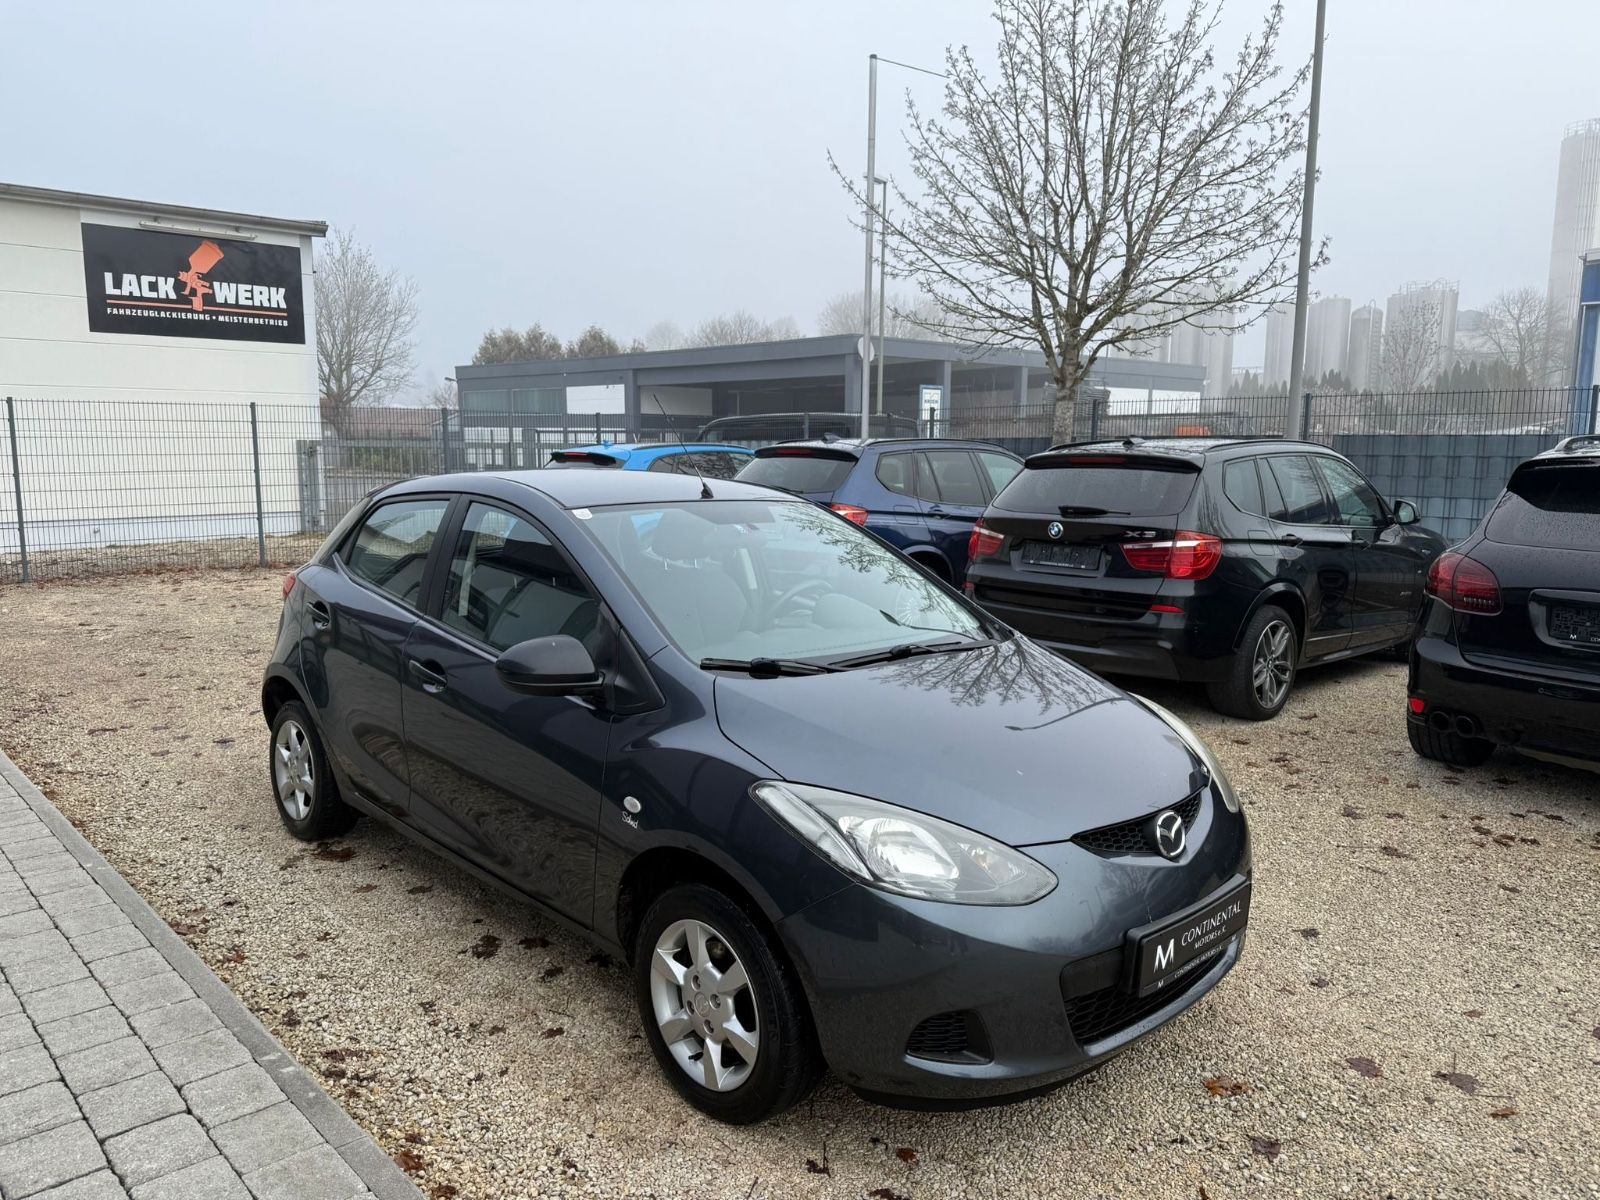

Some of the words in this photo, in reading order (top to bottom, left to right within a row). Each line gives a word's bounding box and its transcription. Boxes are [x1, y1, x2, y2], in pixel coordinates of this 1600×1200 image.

[104, 272, 177, 299] LACK
[213, 281, 287, 308] WERK
[107, 307, 211, 321] FAHRZEUGLACKIERUNG
[218, 315, 289, 327] MEISTERBETRIEB
[1181, 901, 1241, 946] CONTINENTAL
[1193, 929, 1219, 950] MOTORS
[1153, 938, 1175, 973] M
